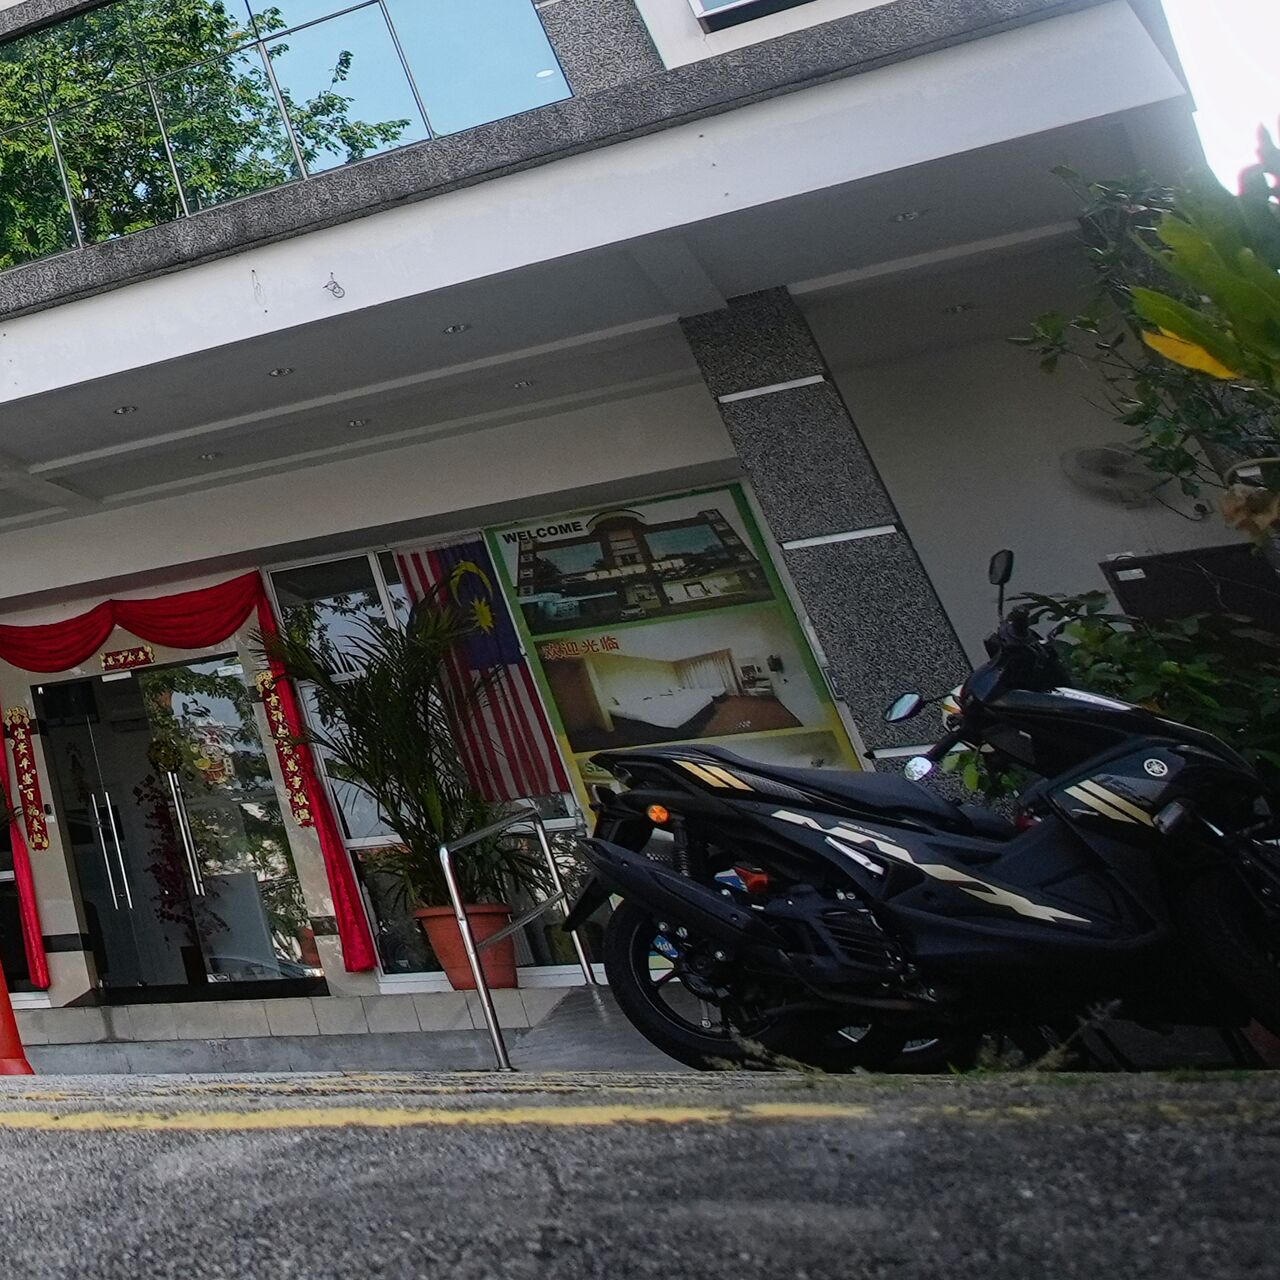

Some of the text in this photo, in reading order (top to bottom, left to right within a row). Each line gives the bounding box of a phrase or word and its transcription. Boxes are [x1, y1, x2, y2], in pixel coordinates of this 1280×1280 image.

[501, 520, 583, 546] WELCOME
[541, 635, 620, 661] 欢迎光临
